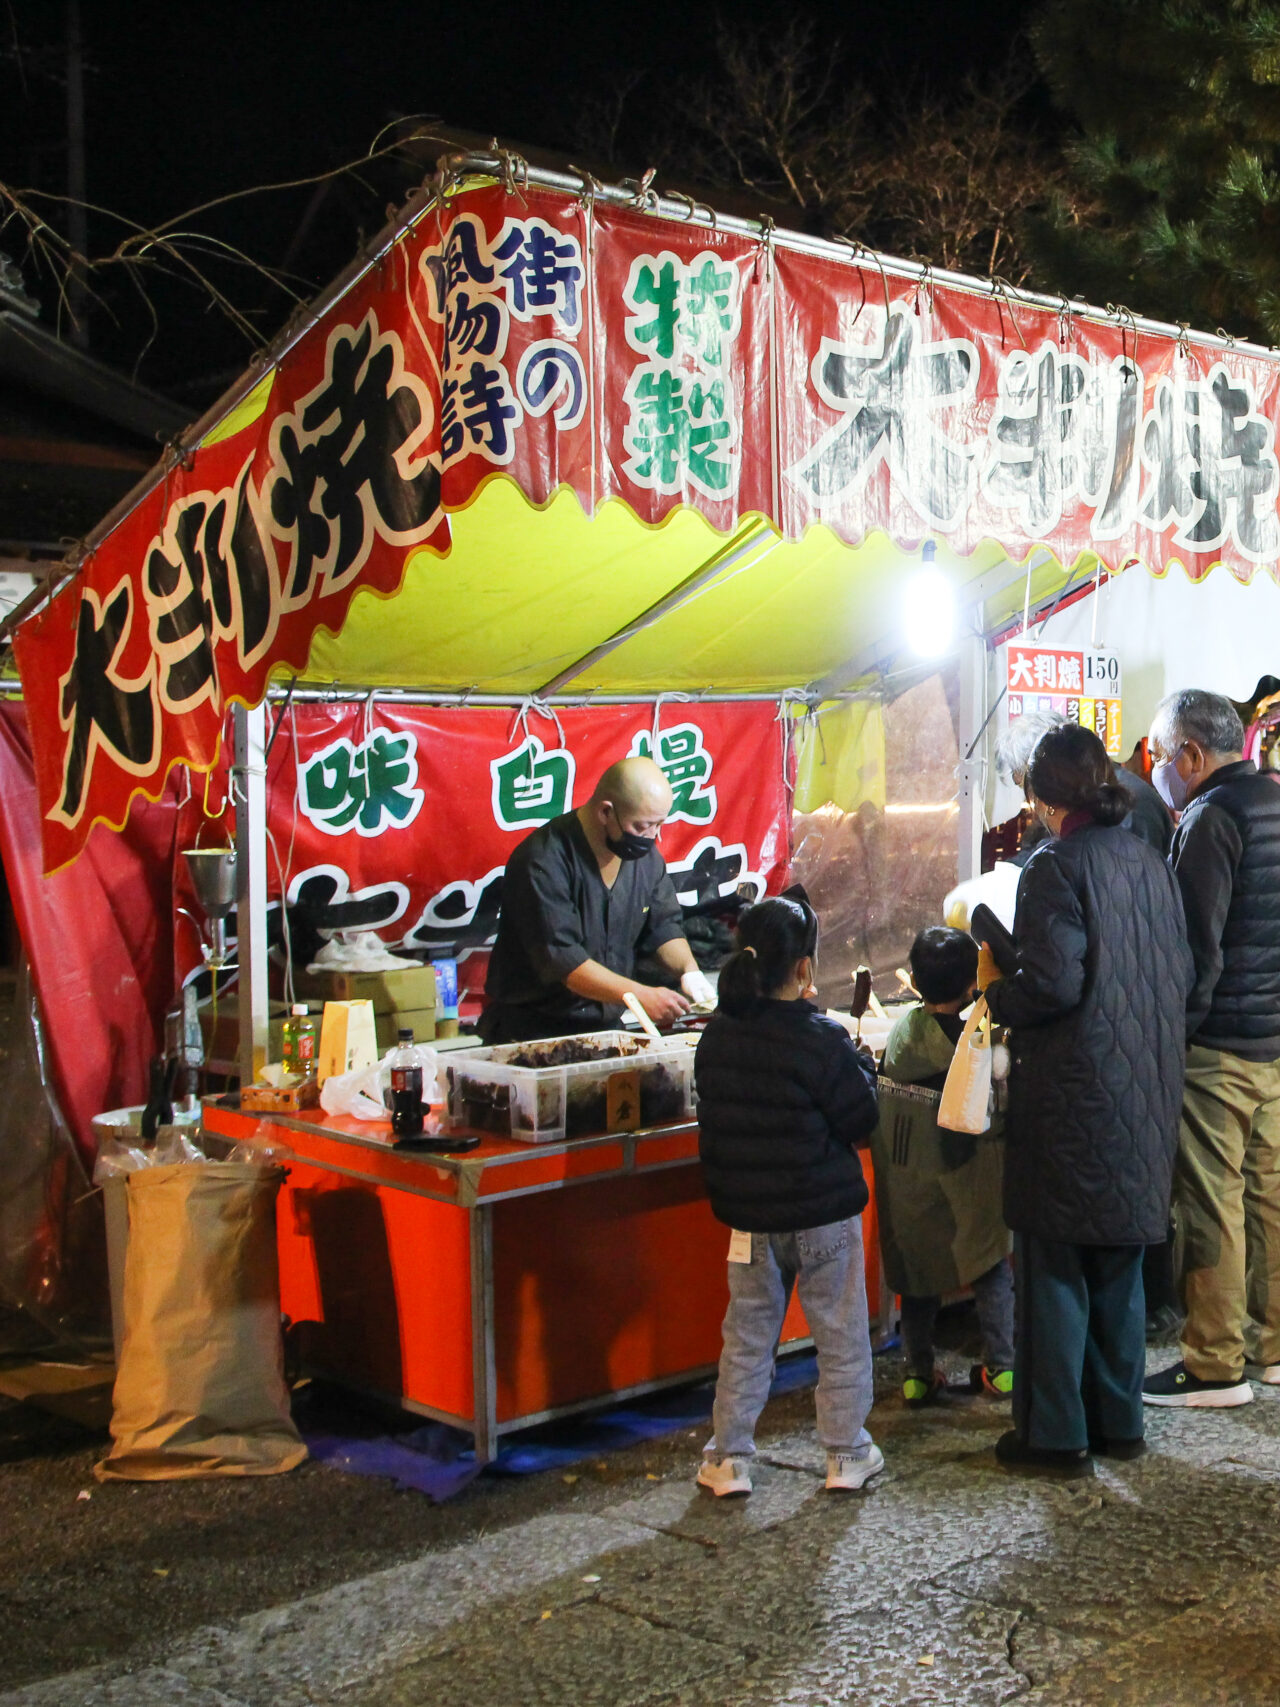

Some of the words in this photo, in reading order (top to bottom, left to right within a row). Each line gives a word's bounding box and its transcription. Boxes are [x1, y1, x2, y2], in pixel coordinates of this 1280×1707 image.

[420, 211, 522, 466] 風物詩
[492, 216, 586, 431] 街の
[625, 250, 742, 501] 特製
[48, 308, 446, 829] 大判焼
[1010, 653, 1082, 690] 大判焼
[1086, 656, 1119, 681] 150
[1108, 702, 1121, 749] チーズ
